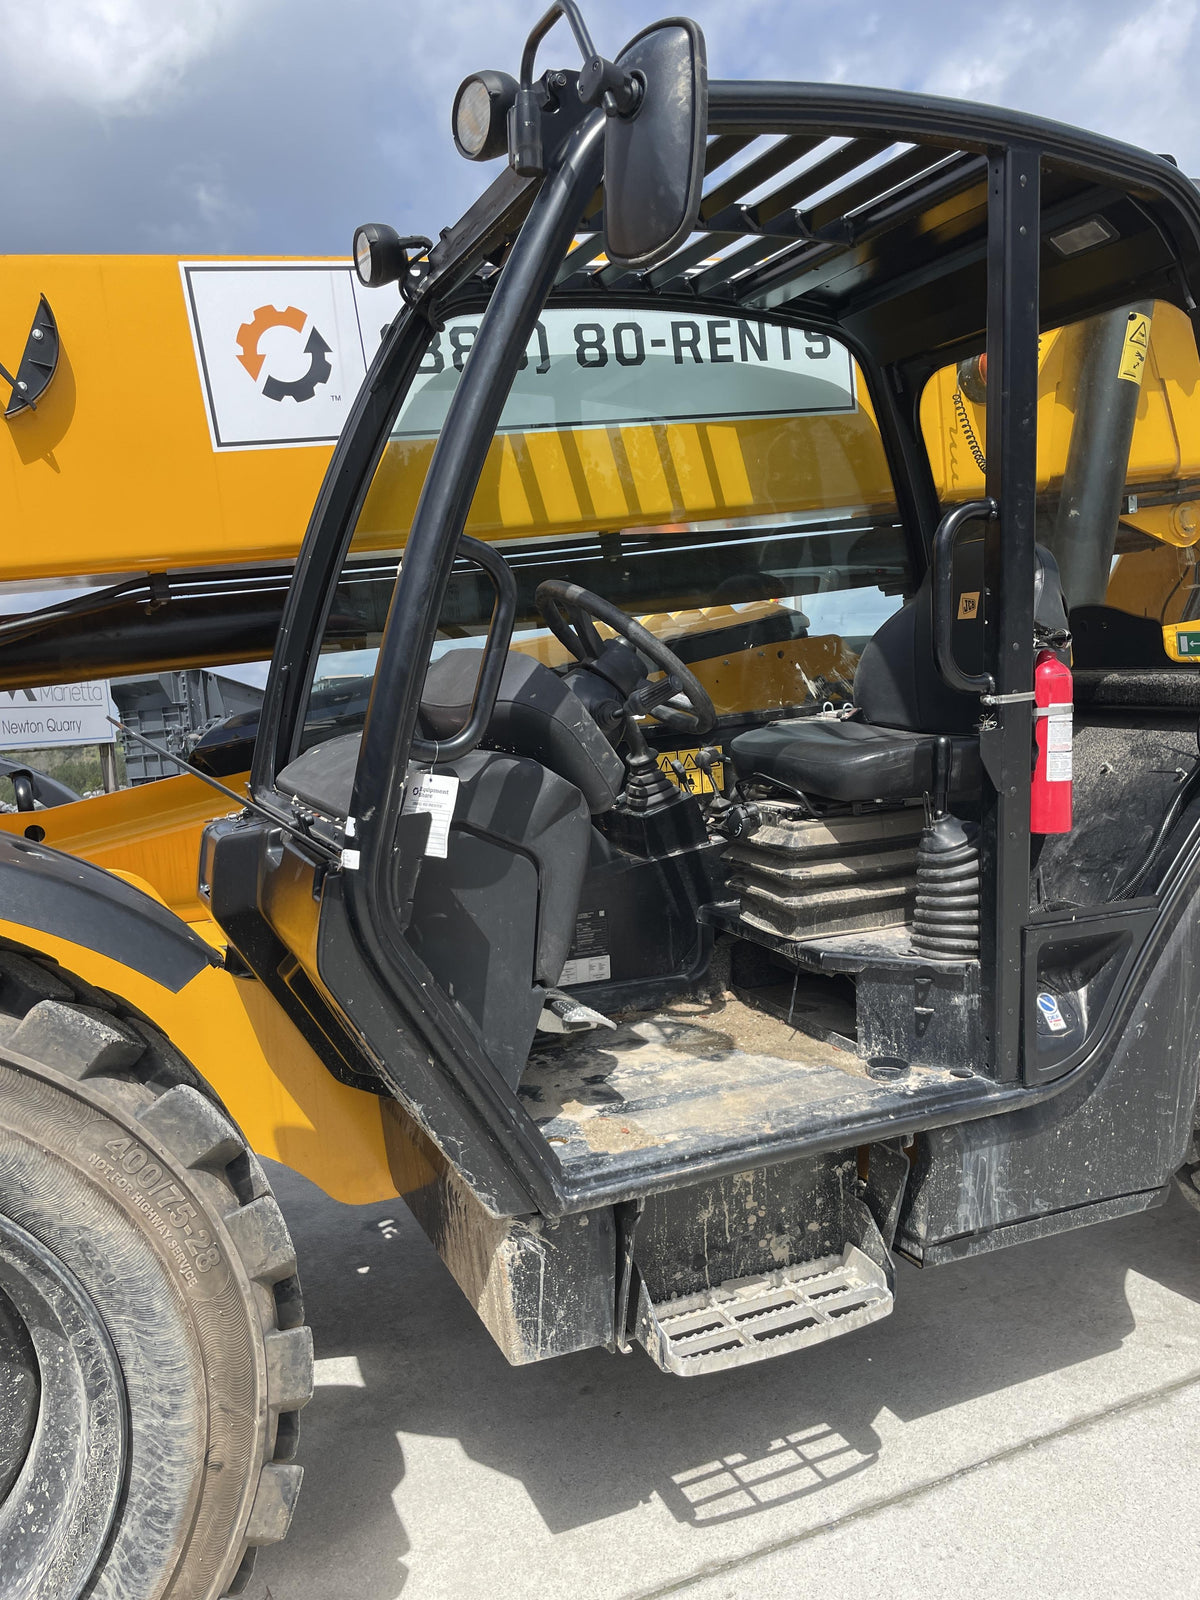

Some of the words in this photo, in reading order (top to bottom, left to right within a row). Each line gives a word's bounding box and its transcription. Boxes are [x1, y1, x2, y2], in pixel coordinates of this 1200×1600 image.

[573, 319, 832, 368] 80-RENTS
[963, 599, 976, 612] JCB
[2, 720, 44, 735] Newton
[46, 718, 82, 733] Quarry
[88, 1153, 114, 1175] NOT
[110, 1172, 134, 1195] FOR
[131, 1192, 173, 1240] HIGHWAY
[168, 1240, 198, 1288] SERVICE
[105, 1137, 221, 1273] 400/75-28
